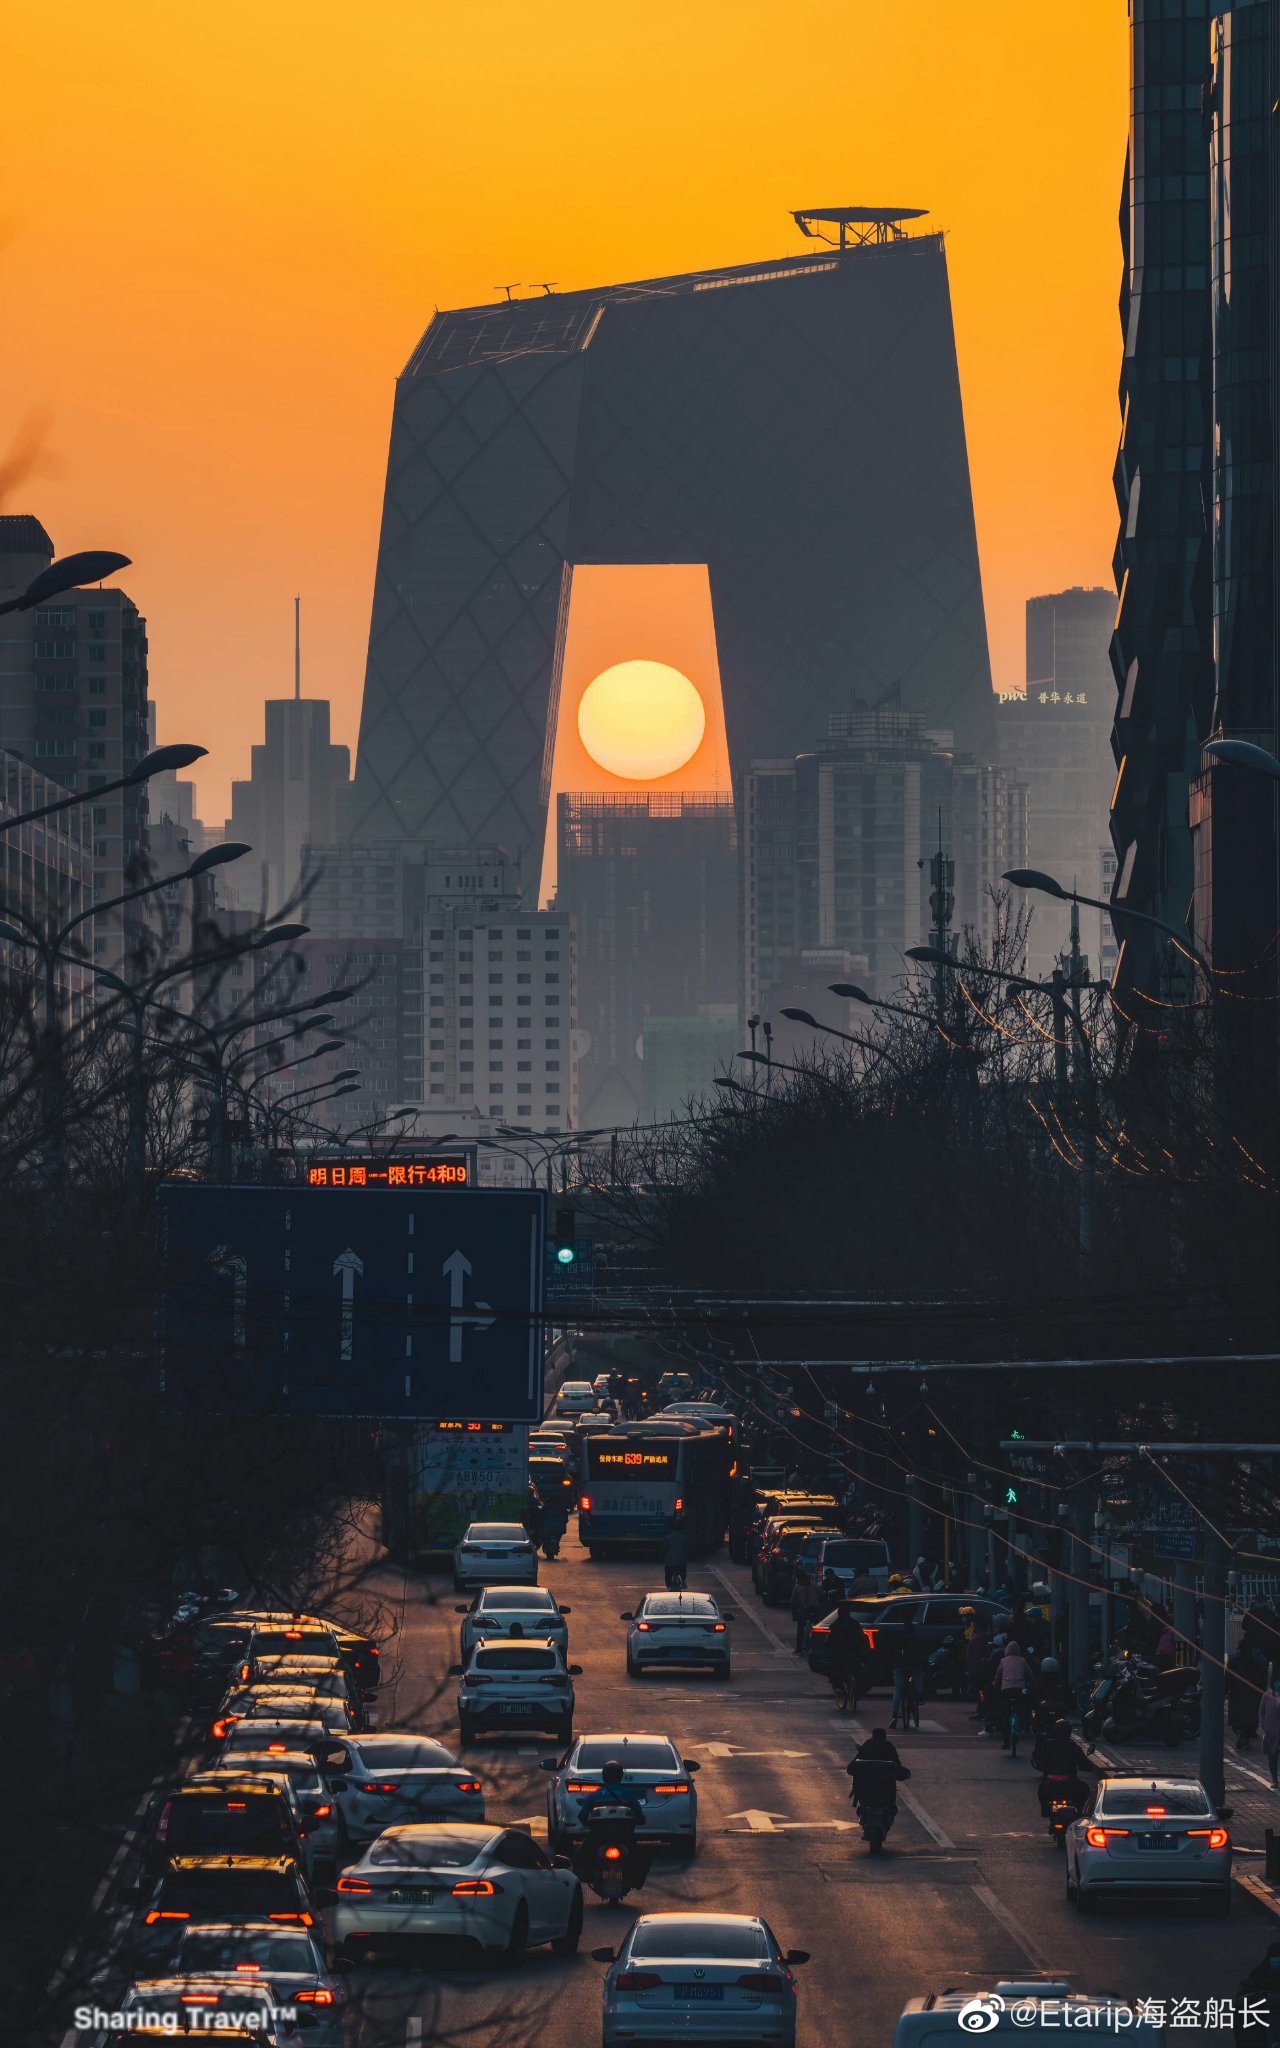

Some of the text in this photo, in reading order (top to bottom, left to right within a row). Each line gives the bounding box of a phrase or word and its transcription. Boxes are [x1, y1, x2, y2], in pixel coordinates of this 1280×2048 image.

[998, 692, 1028, 704] pwc
[1037, 691, 1088, 704] 普华永道
[309, 1164, 467, 1186] 明日周一限行4和9
[624, 1453, 643, 1465] 639
